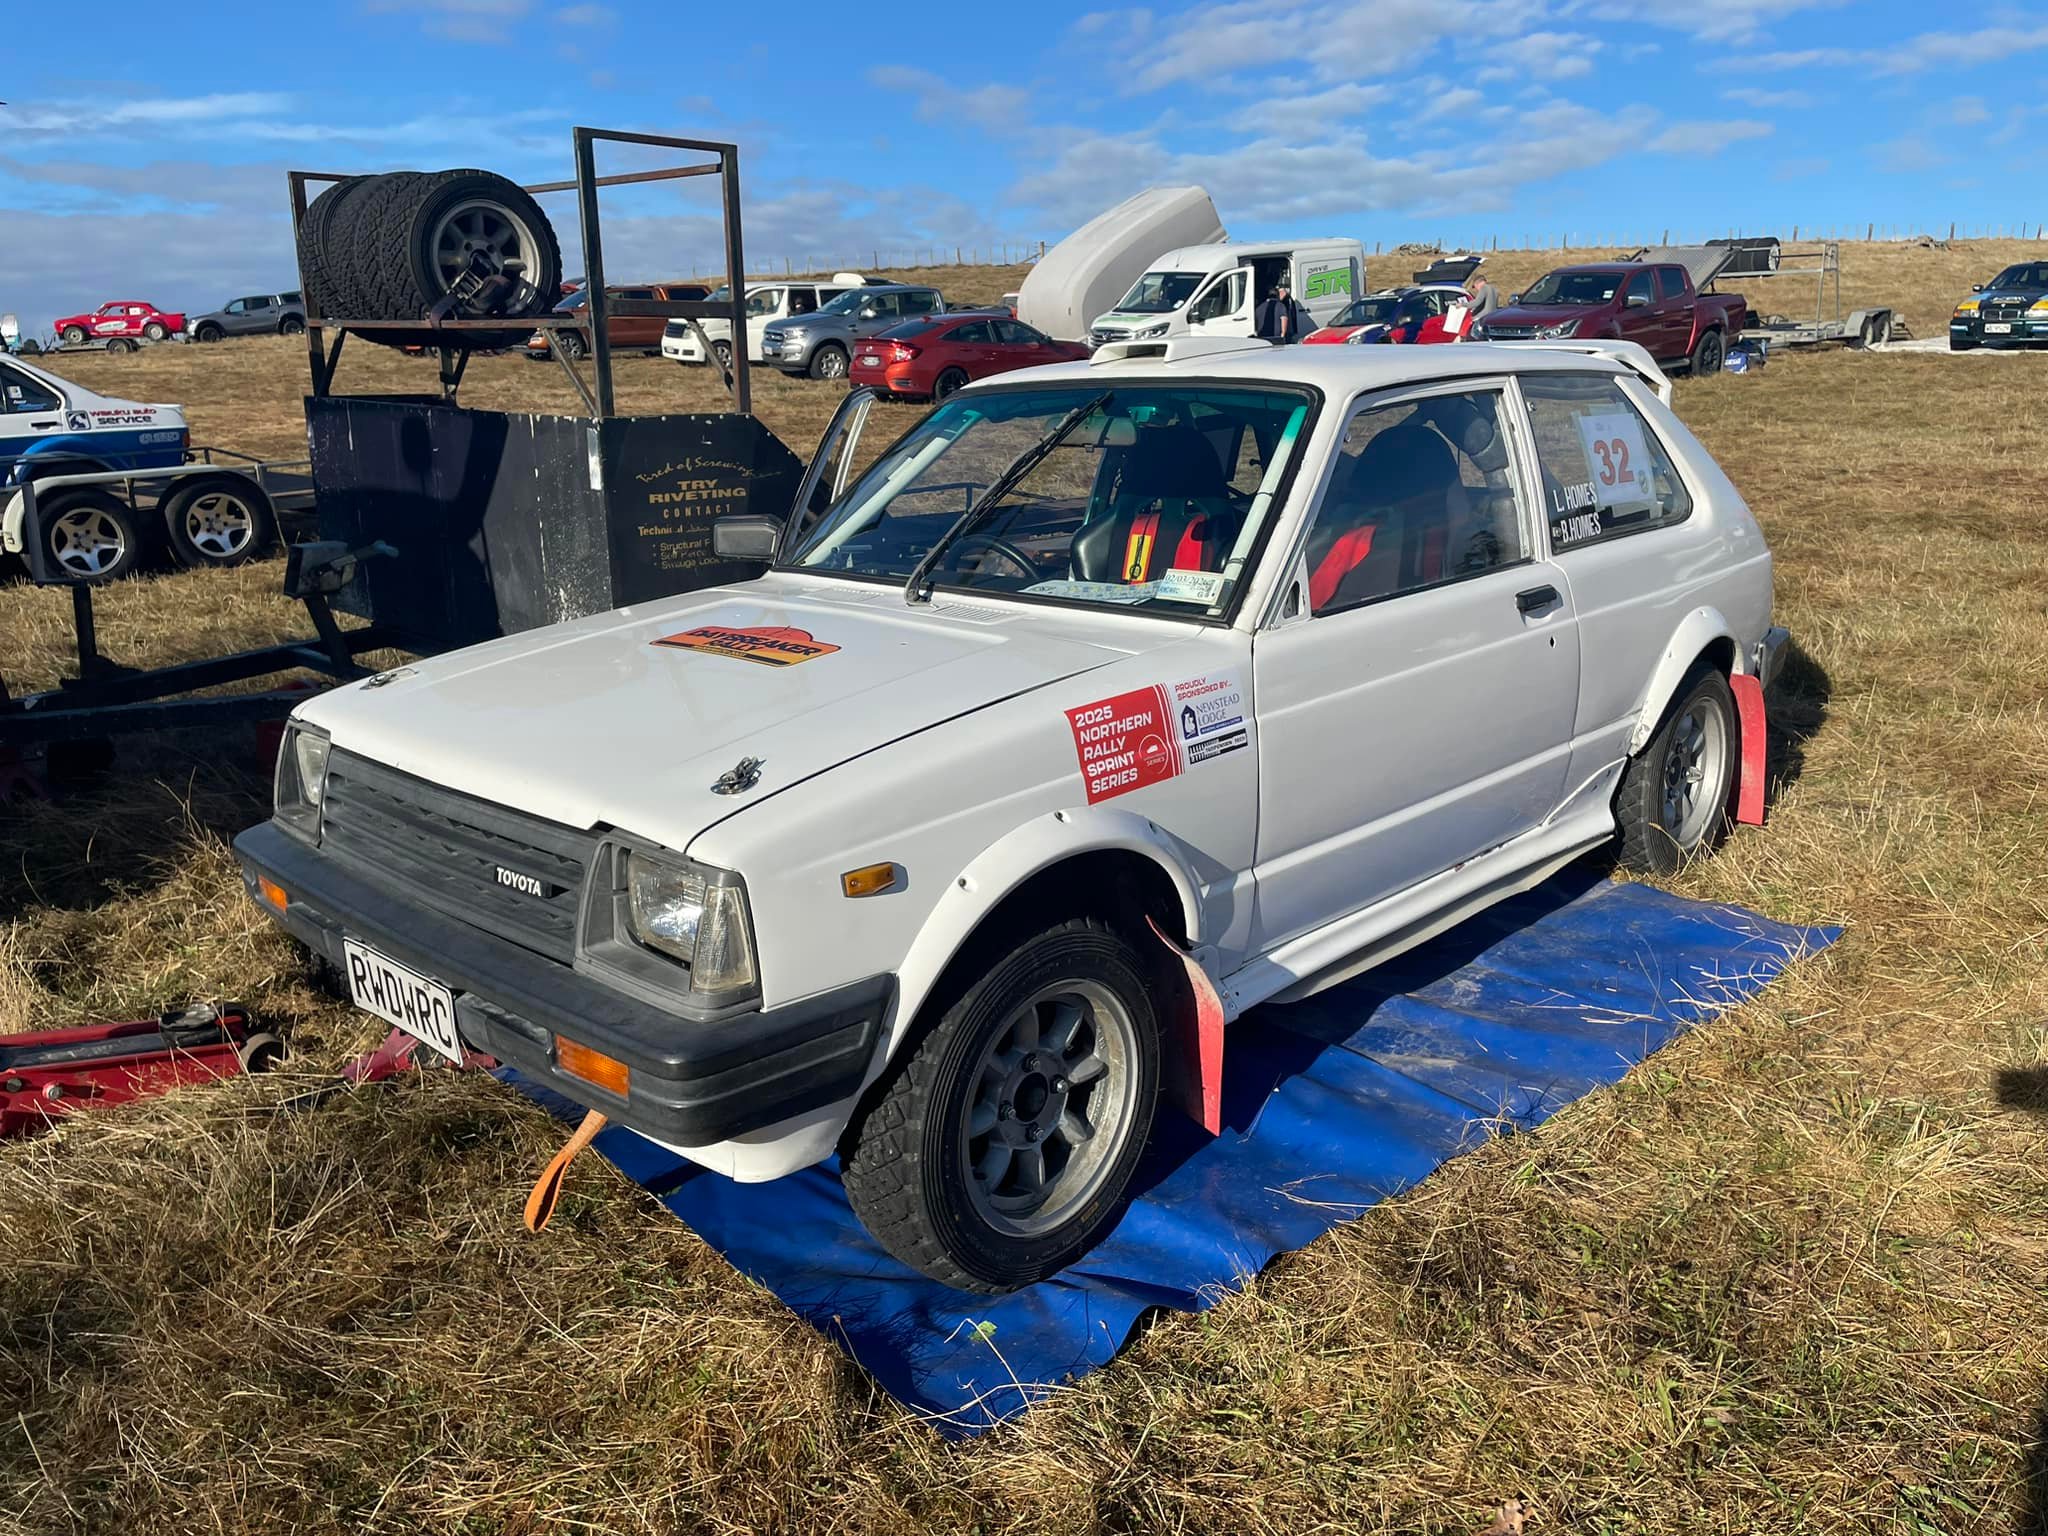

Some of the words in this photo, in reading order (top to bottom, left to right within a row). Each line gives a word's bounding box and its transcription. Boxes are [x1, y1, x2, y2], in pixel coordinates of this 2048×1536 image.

[676, 457, 693, 472] of
[1594, 438, 1634, 486] 32
[648, 487, 747, 504] RIVETING
[677, 479, 719, 491] TRY
[1564, 482, 1598, 510] HOMES
[1174, 677, 1207, 692] PROUDLY
[1177, 683, 1219, 701] SPONSORED
[1195, 693, 1240, 713] NEWSTEAD
[1075, 705, 1113, 728] 2025
[1080, 711, 1152, 744] NORTHERN
[1198, 709, 1227, 727] LODGE
[1083, 736, 1126, 761] RALLY
[1087, 751, 1135, 777] SPRINT
[1091, 767, 1138, 794] SERIES
[496, 866, 542, 897] TOYOTA
[350, 953, 452, 1048] RWDWRC
